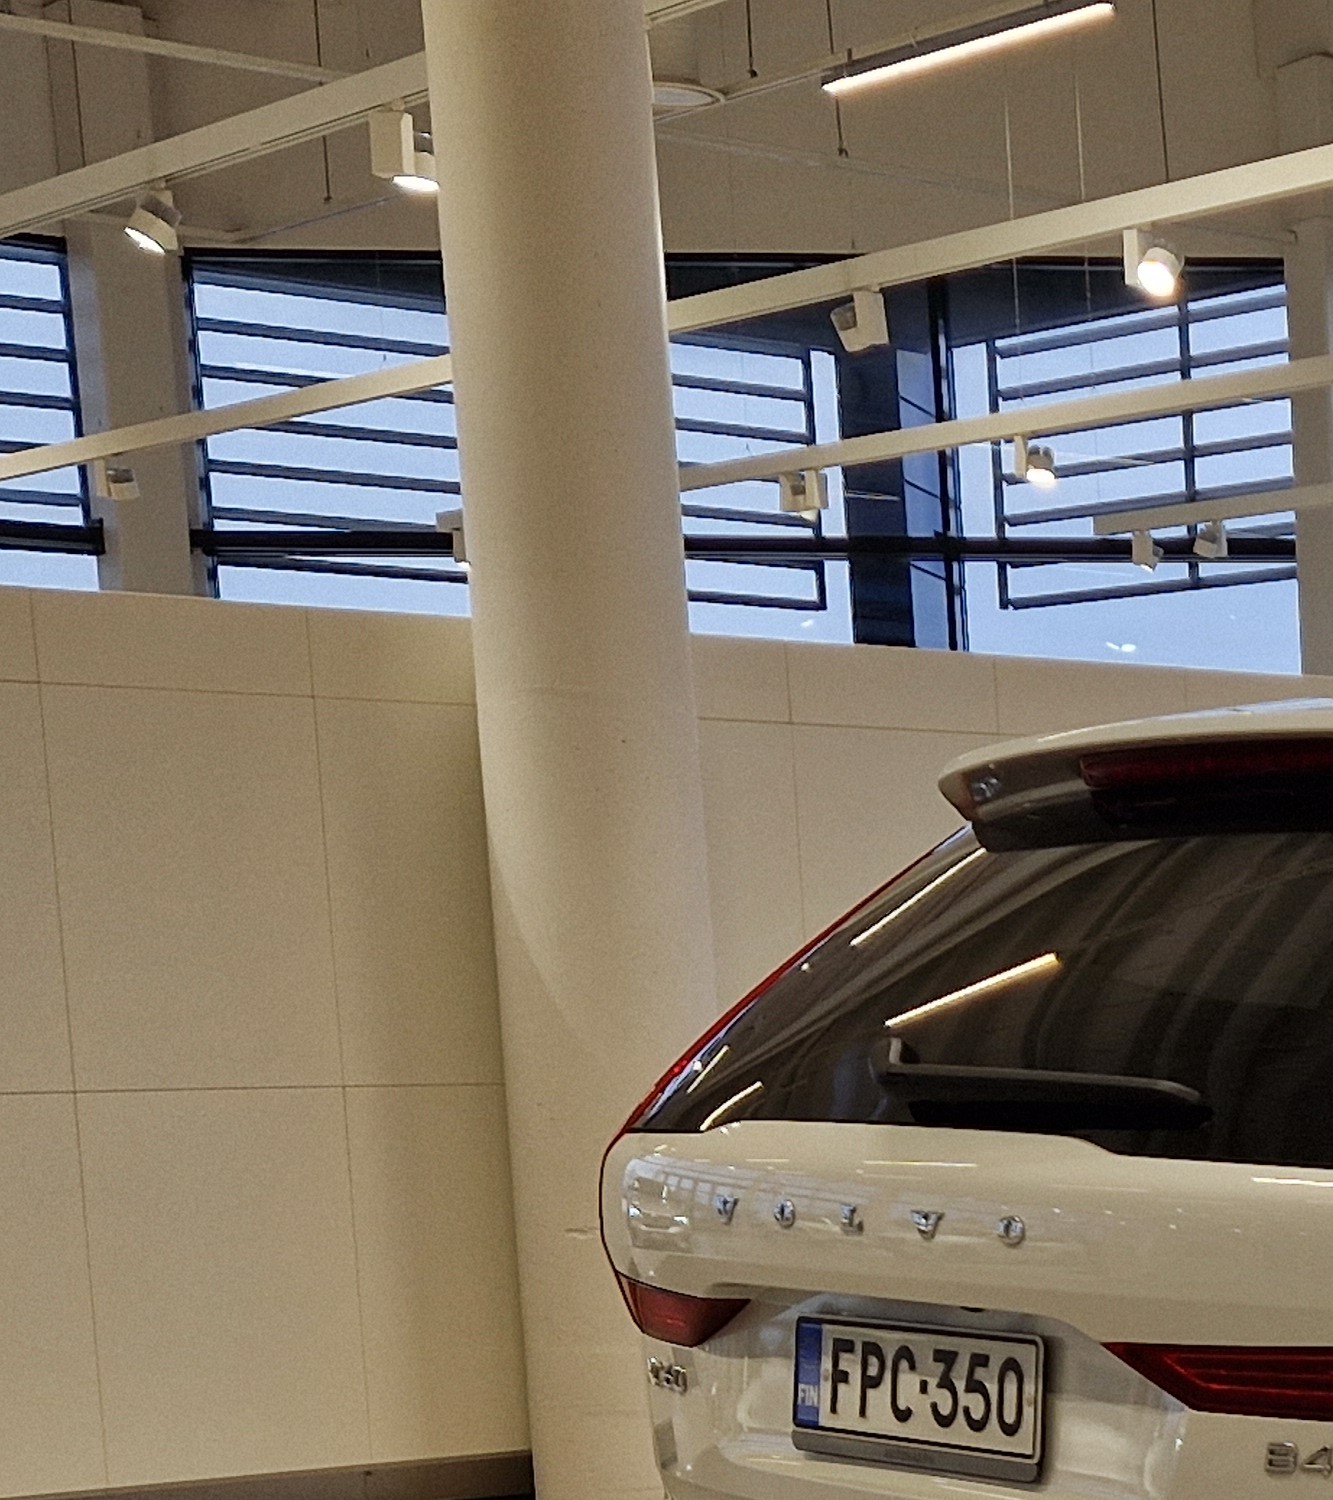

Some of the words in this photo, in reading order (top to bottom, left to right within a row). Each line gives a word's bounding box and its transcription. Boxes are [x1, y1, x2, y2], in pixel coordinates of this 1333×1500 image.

[714, 1194, 1026, 1247] VOLVO
[798, 1383, 819, 1408] FIN
[830, 1336, 1024, 1437] FPC-350
